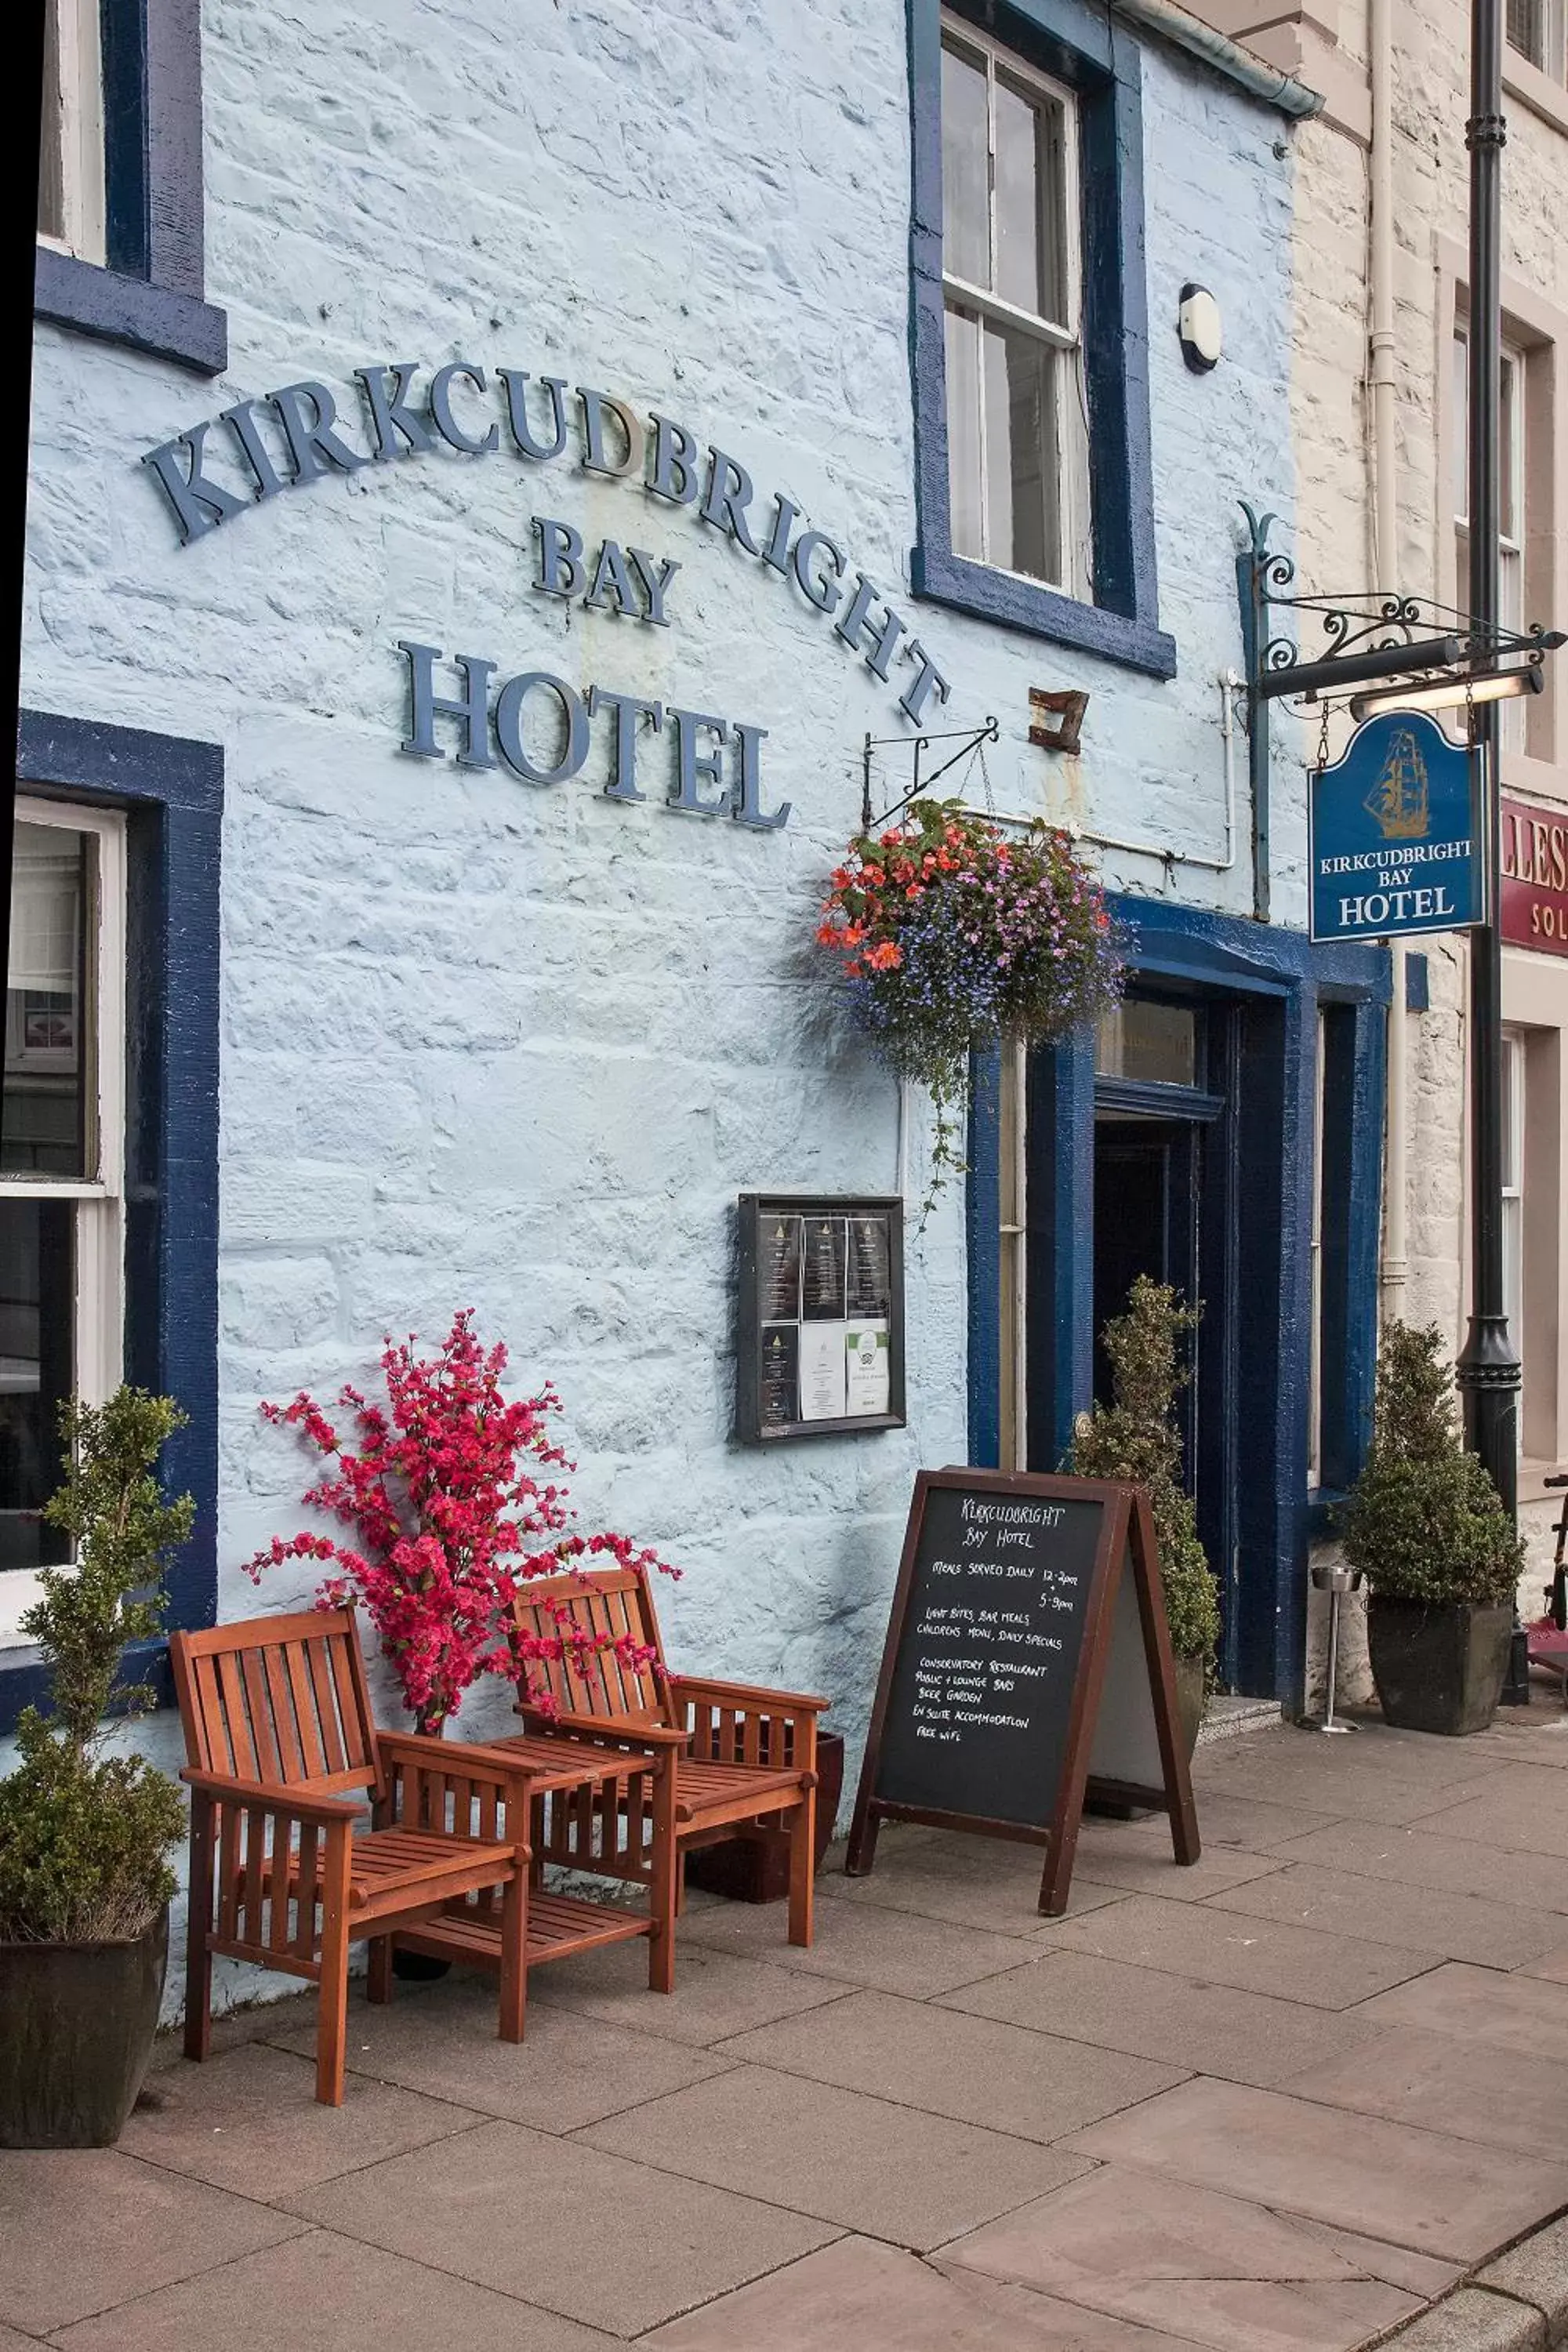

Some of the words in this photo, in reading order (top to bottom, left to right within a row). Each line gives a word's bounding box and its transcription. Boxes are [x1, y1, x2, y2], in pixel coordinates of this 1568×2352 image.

[140, 361, 951, 728] KIRKCUDBRIGHT
[530, 515, 683, 626] BAY
[397, 639, 792, 829] HOTEL
[1320, 840, 1473, 875] KIRKCUDBRIGHT
[1501, 811, 1568, 892] LLES
[1378, 868, 1413, 887] BAY
[1338, 887, 1454, 927] HOTEL
[963, 1526, 988, 1548] BAY
[996, 1528, 1035, 1548] HOTEL
[932, 1561, 962, 1575] MEALS
[967, 1563, 1003, 1577] SERVED
[1006, 1566, 1035, 1578] DAILY
[978, 1610, 998, 1624] BAR
[998, 1631, 1023, 1643] DAILY
[1025, 1635, 1063, 1650] SPECIALS
[920, 1657, 984, 1671] CONSERVATORY
[989, 1660, 1048, 1677] RESTAURANT
[915, 1671, 942, 1685] PUBLIC
[953, 1676, 988, 1688] LOUNGE
[993, 1679, 1015, 1691] BARS
[918, 1687, 942, 1702] BEER
[946, 1690, 982, 1704] GARDEN
[913, 1704, 925, 1716] EN
[927, 1708, 952, 1721] SUITE
[916, 1726, 937, 1738] FREE
